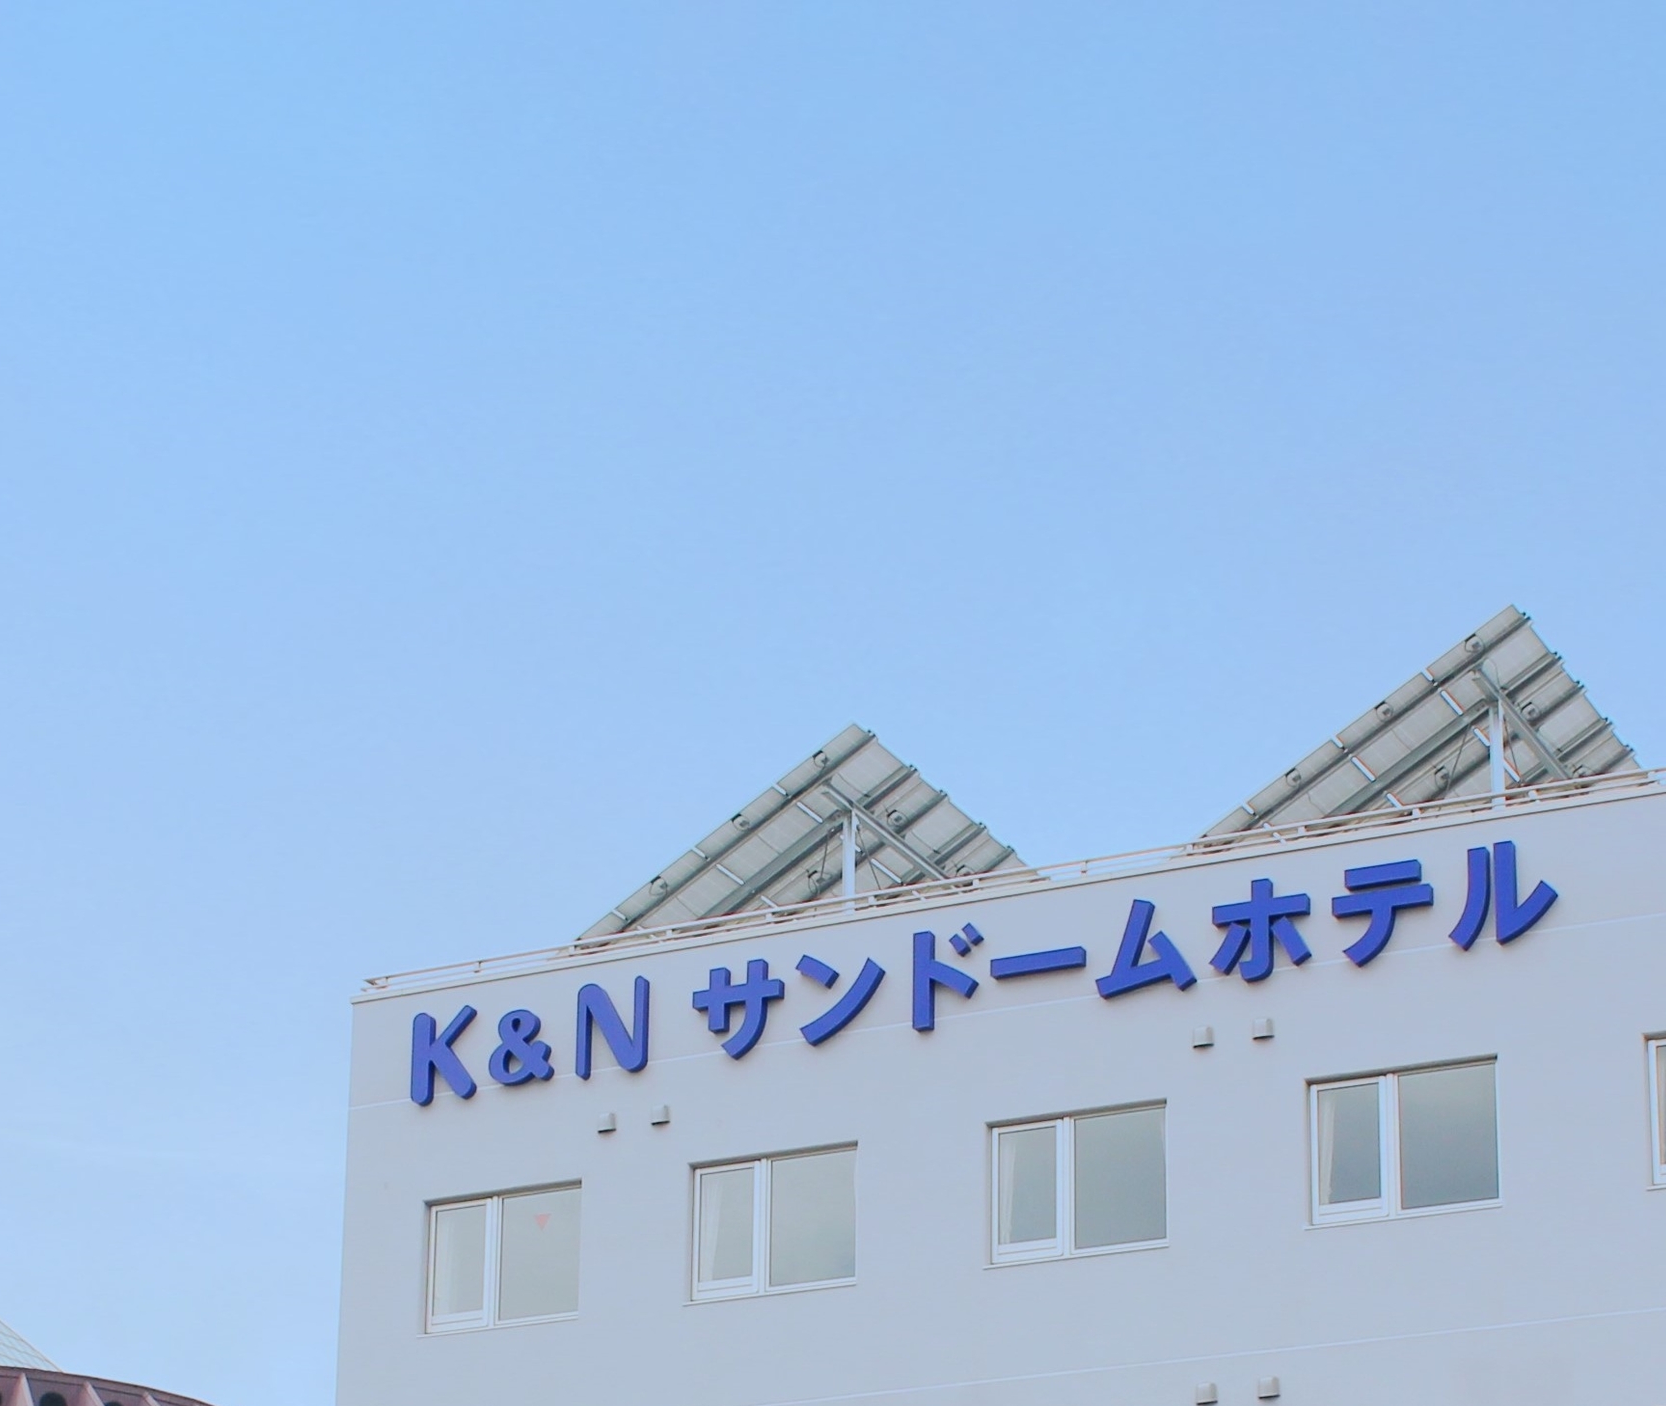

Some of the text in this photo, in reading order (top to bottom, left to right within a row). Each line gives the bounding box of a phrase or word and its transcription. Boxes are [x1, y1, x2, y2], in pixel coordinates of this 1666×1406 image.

[410, 840, 1560, 1107] K&N サンドームホテル
